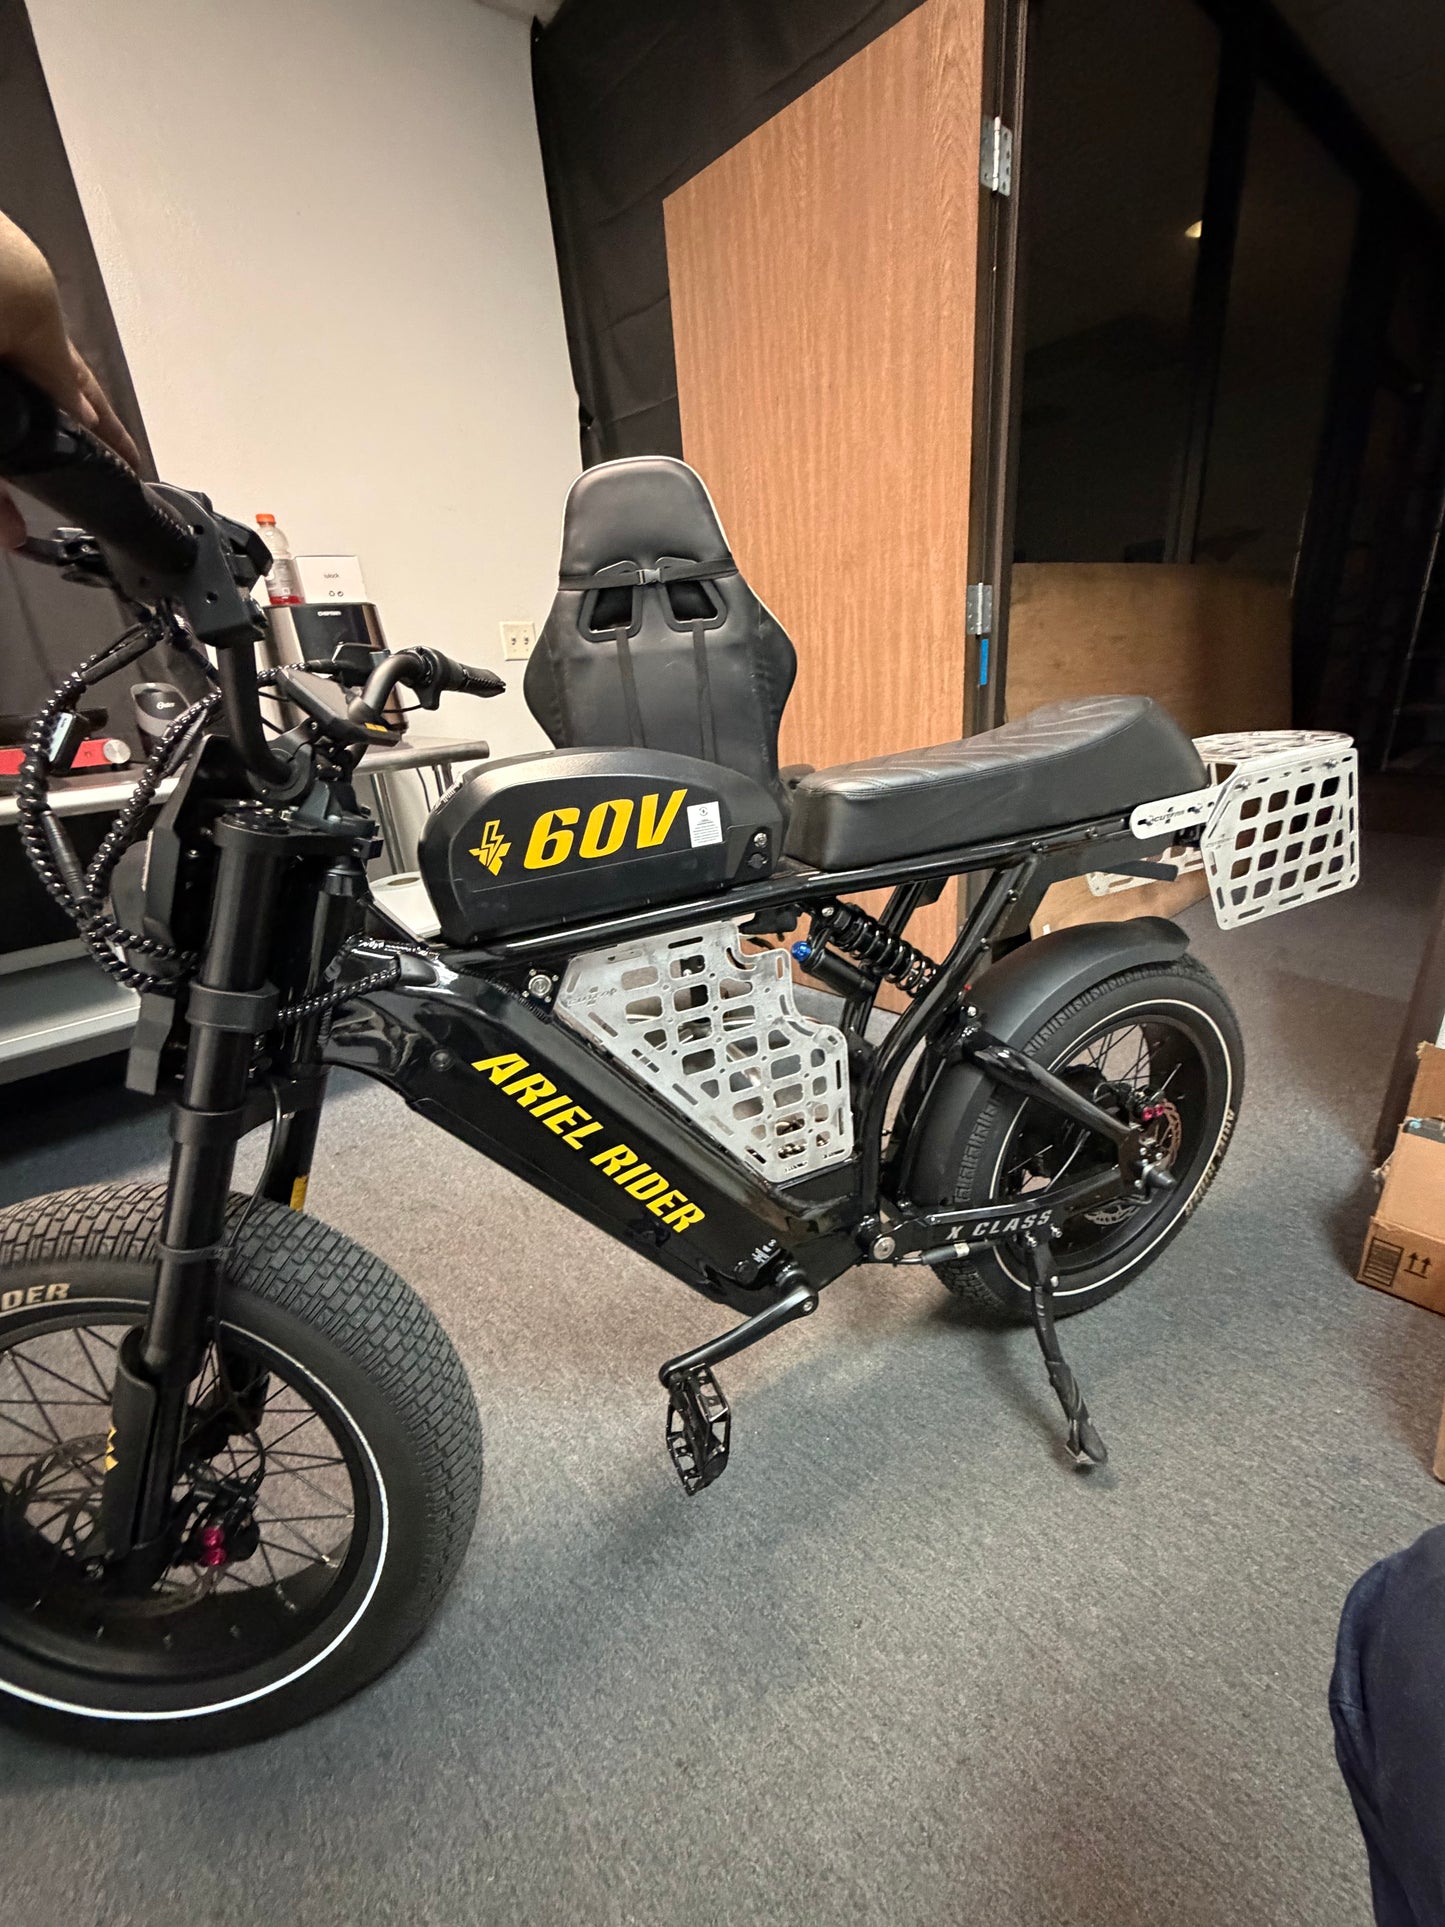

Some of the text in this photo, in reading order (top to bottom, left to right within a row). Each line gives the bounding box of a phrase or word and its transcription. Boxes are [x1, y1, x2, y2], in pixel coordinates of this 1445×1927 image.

[523, 790, 687, 876] 60V
[471, 1052, 704, 1233] ARIEL RIDER
[945, 1209, 1053, 1241] X CLASS
[1, 1283, 71, 1310] DER
